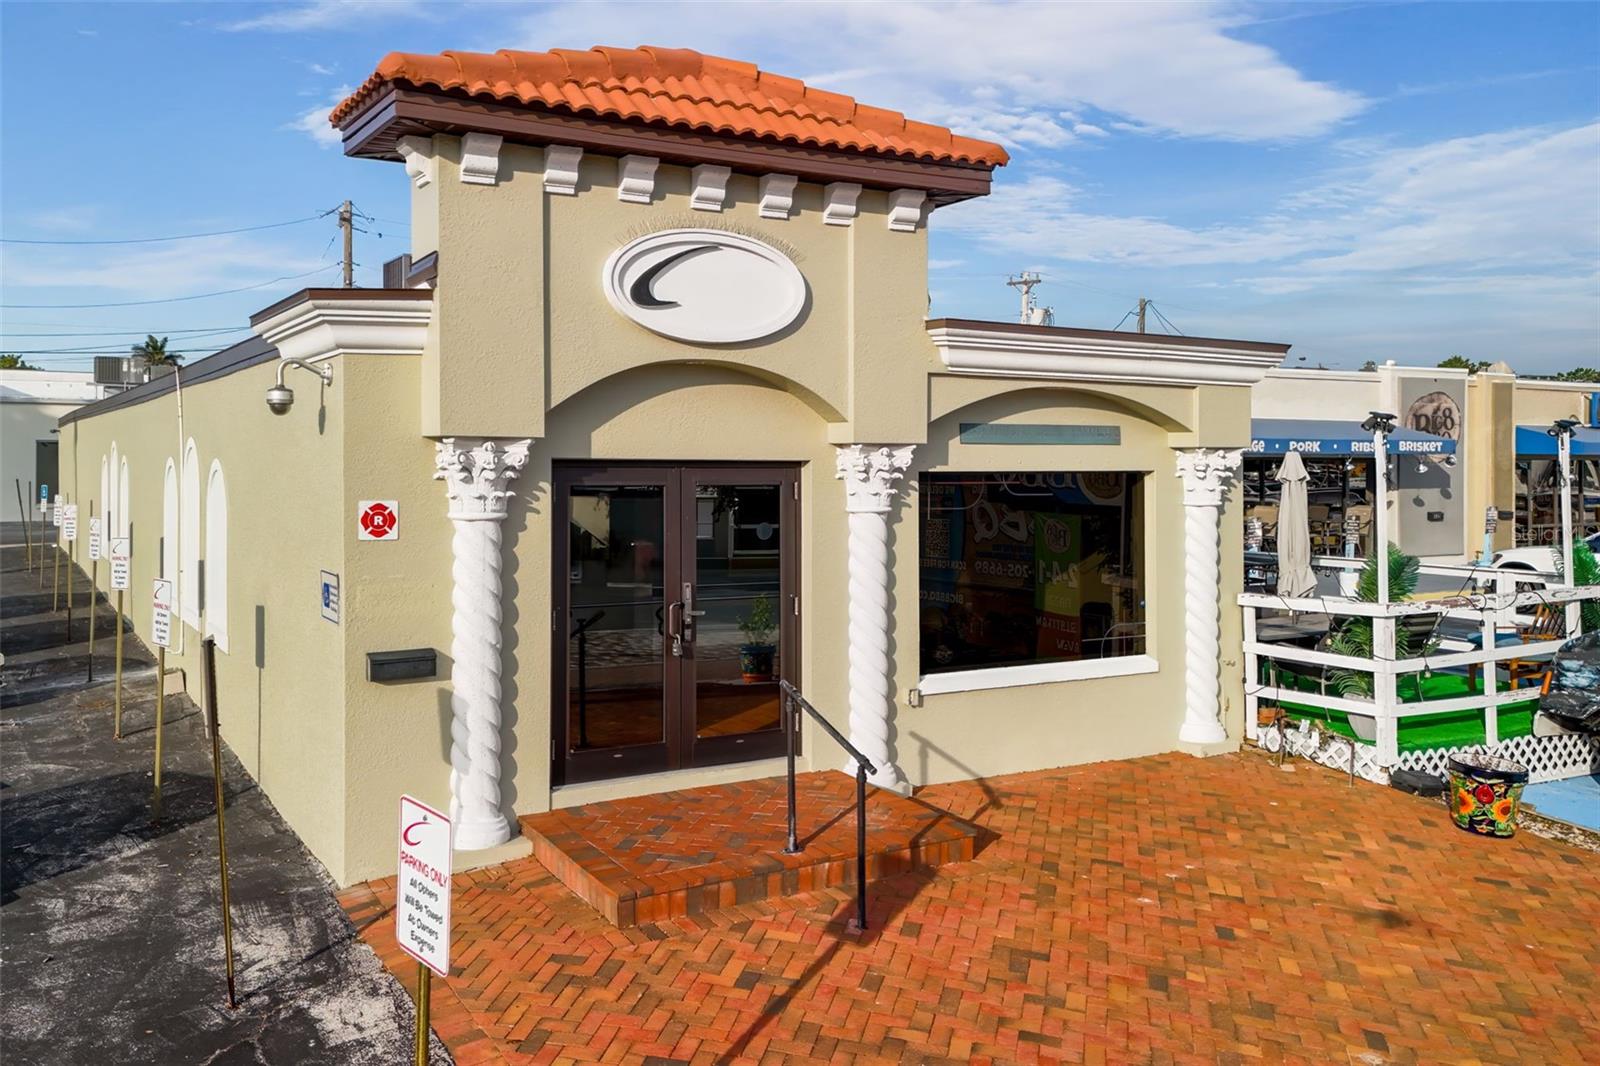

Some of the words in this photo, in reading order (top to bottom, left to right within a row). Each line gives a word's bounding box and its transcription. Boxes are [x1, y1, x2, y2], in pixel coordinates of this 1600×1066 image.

[374, 515, 383, 525] R
[400, 851, 428, 877] PARKING
[430, 867, 448, 888] ONLY
